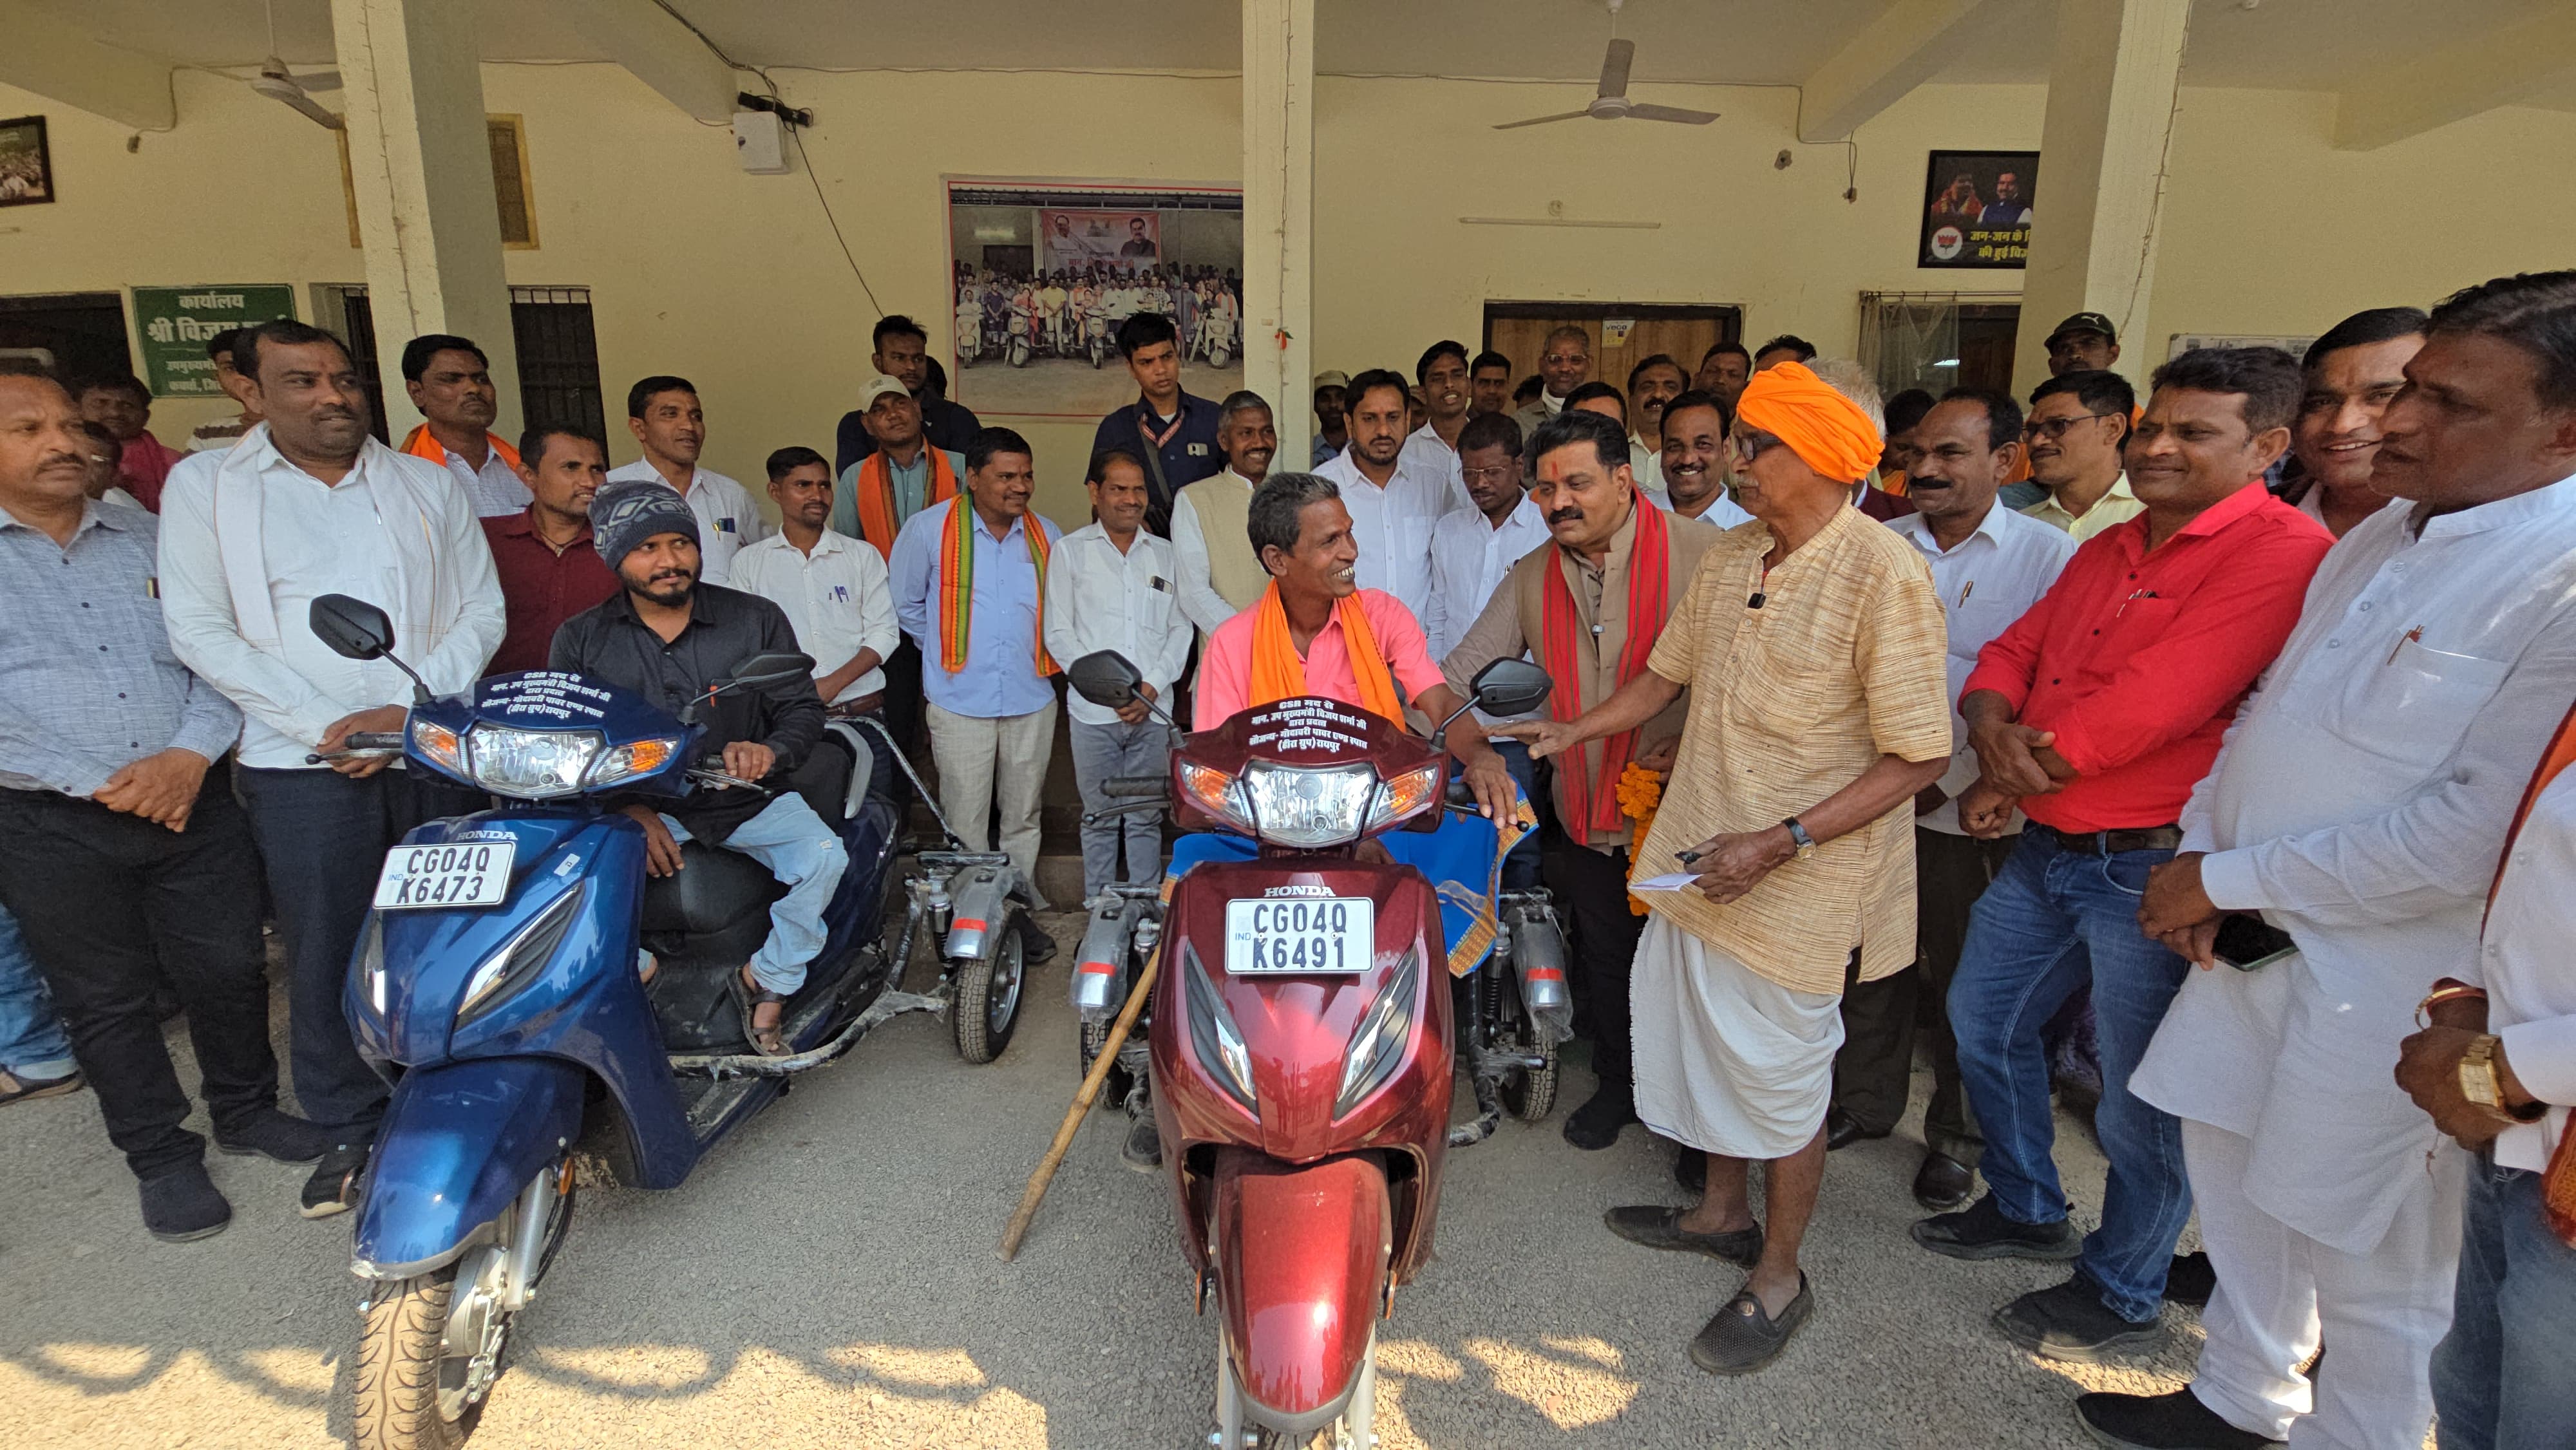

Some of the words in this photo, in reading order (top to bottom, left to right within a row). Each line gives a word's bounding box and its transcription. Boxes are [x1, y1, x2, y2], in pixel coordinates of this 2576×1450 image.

[2010, 245, 2029, 258] विज
[178, 291, 245, 309] कार्यालय
[147, 317, 175, 343] श्री
[557, 680, 582, 693] विजय
[1279, 700, 1302, 710] CSR
[1283, 707, 1316, 721] मुख्यमंत्री
[1317, 709, 1339, 722] विजय
[1340, 716, 1355, 726] शर्मा
[1356, 719, 1367, 730] जी
[456, 831, 518, 841] HONDA
[407, 847, 490, 874] CG04Q
[396, 876, 484, 905] K6473
[1264, 886, 1336, 897] HONDA
[1254, 903, 1347, 933] CG04Q
[1235, 932, 1251, 941] IND
[1253, 937, 1343, 968] K6491
